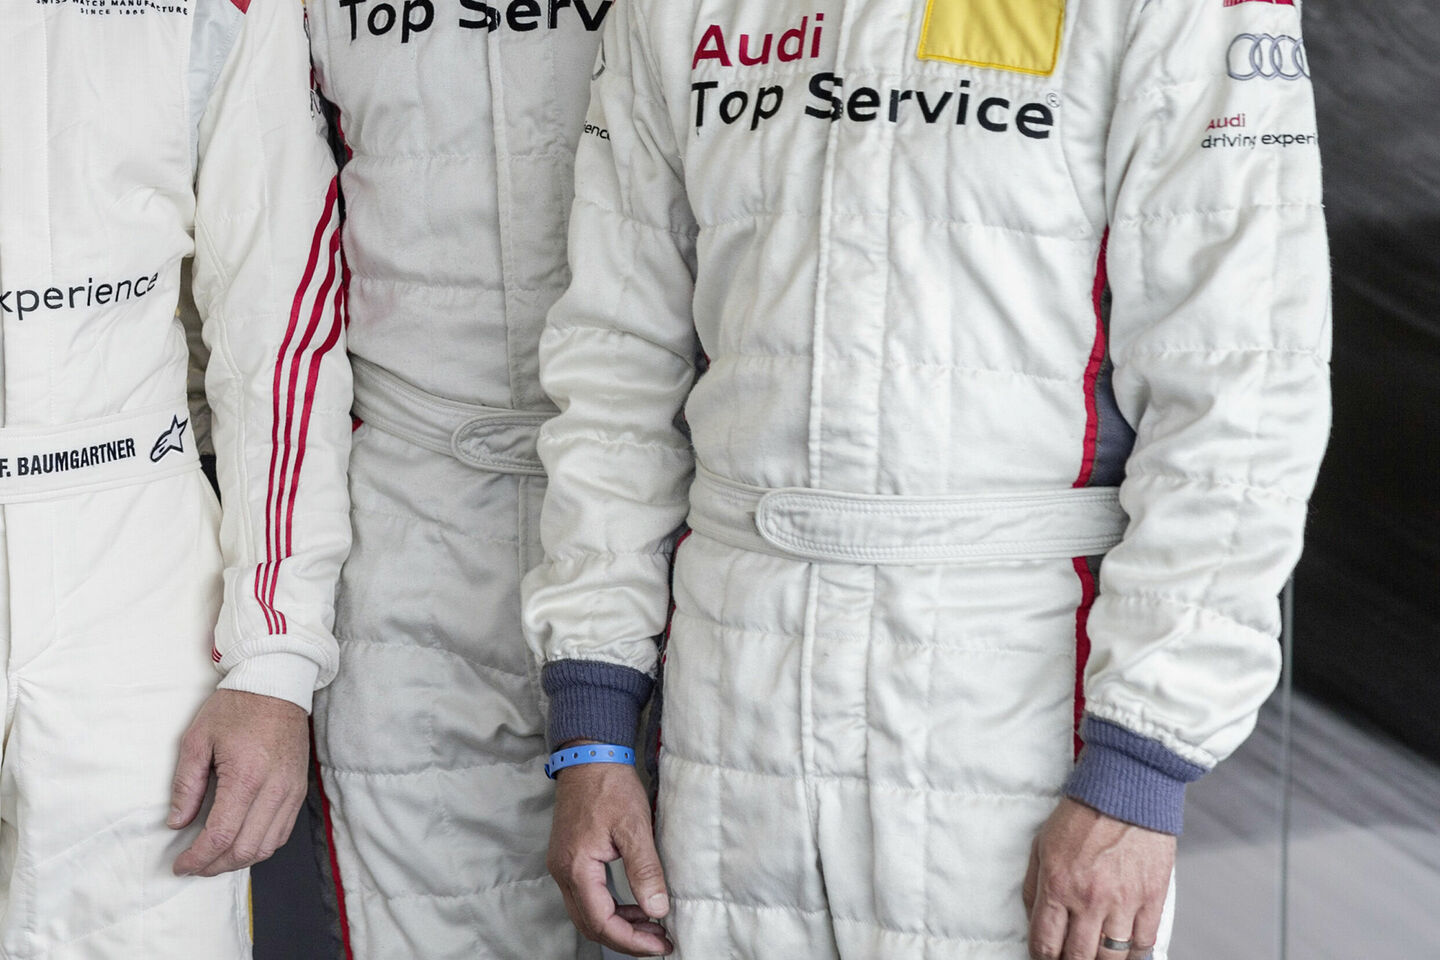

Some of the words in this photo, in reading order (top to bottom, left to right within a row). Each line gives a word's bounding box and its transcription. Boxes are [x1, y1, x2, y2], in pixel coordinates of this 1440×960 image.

[80, 7, 111, 15] SINCE
[111, 0, 188, 15] MANUFACTURE
[691, 13, 824, 70] Audi
[691, 81, 784, 131] Top
[805, 72, 1054, 140] Service
[1205, 113, 1246, 132] Audi
[1261, 133, 1317, 148] experi
[17, 437, 136, 476] BAUMGARTNER
